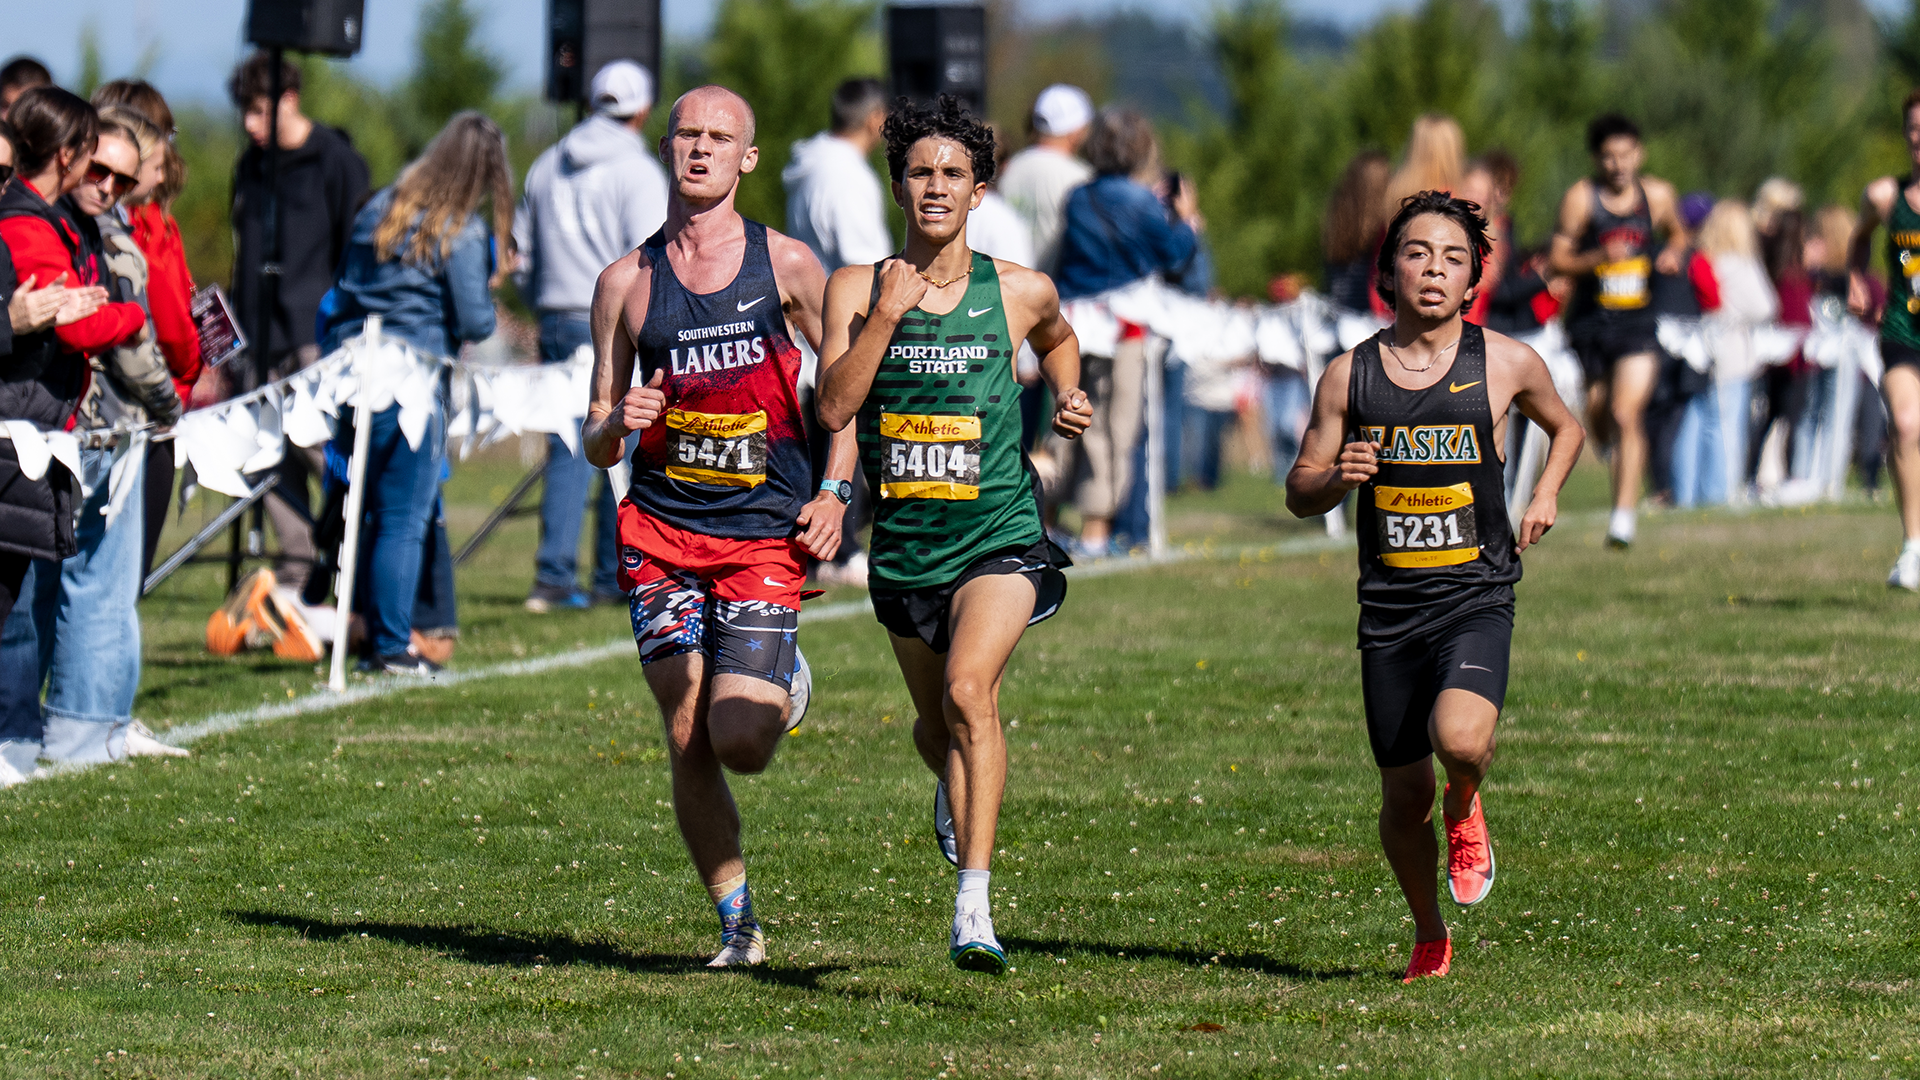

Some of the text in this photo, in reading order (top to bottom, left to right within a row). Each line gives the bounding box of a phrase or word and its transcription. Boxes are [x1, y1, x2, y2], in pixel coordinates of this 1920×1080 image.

[677, 320, 755, 342] SOUTHWESTERN
[669, 336, 765, 376] LAKERS
[889, 345, 989, 361] PORTLAND
[909, 360, 968, 374] STATE
[682, 416, 748, 432] Athletic
[896, 419, 961, 435] Athletic
[678, 434, 753, 470] 5471
[890, 443, 967, 478] 5404
[1389, 492, 1453, 507] Athletic
[1386, 513, 1463, 548] 5231
